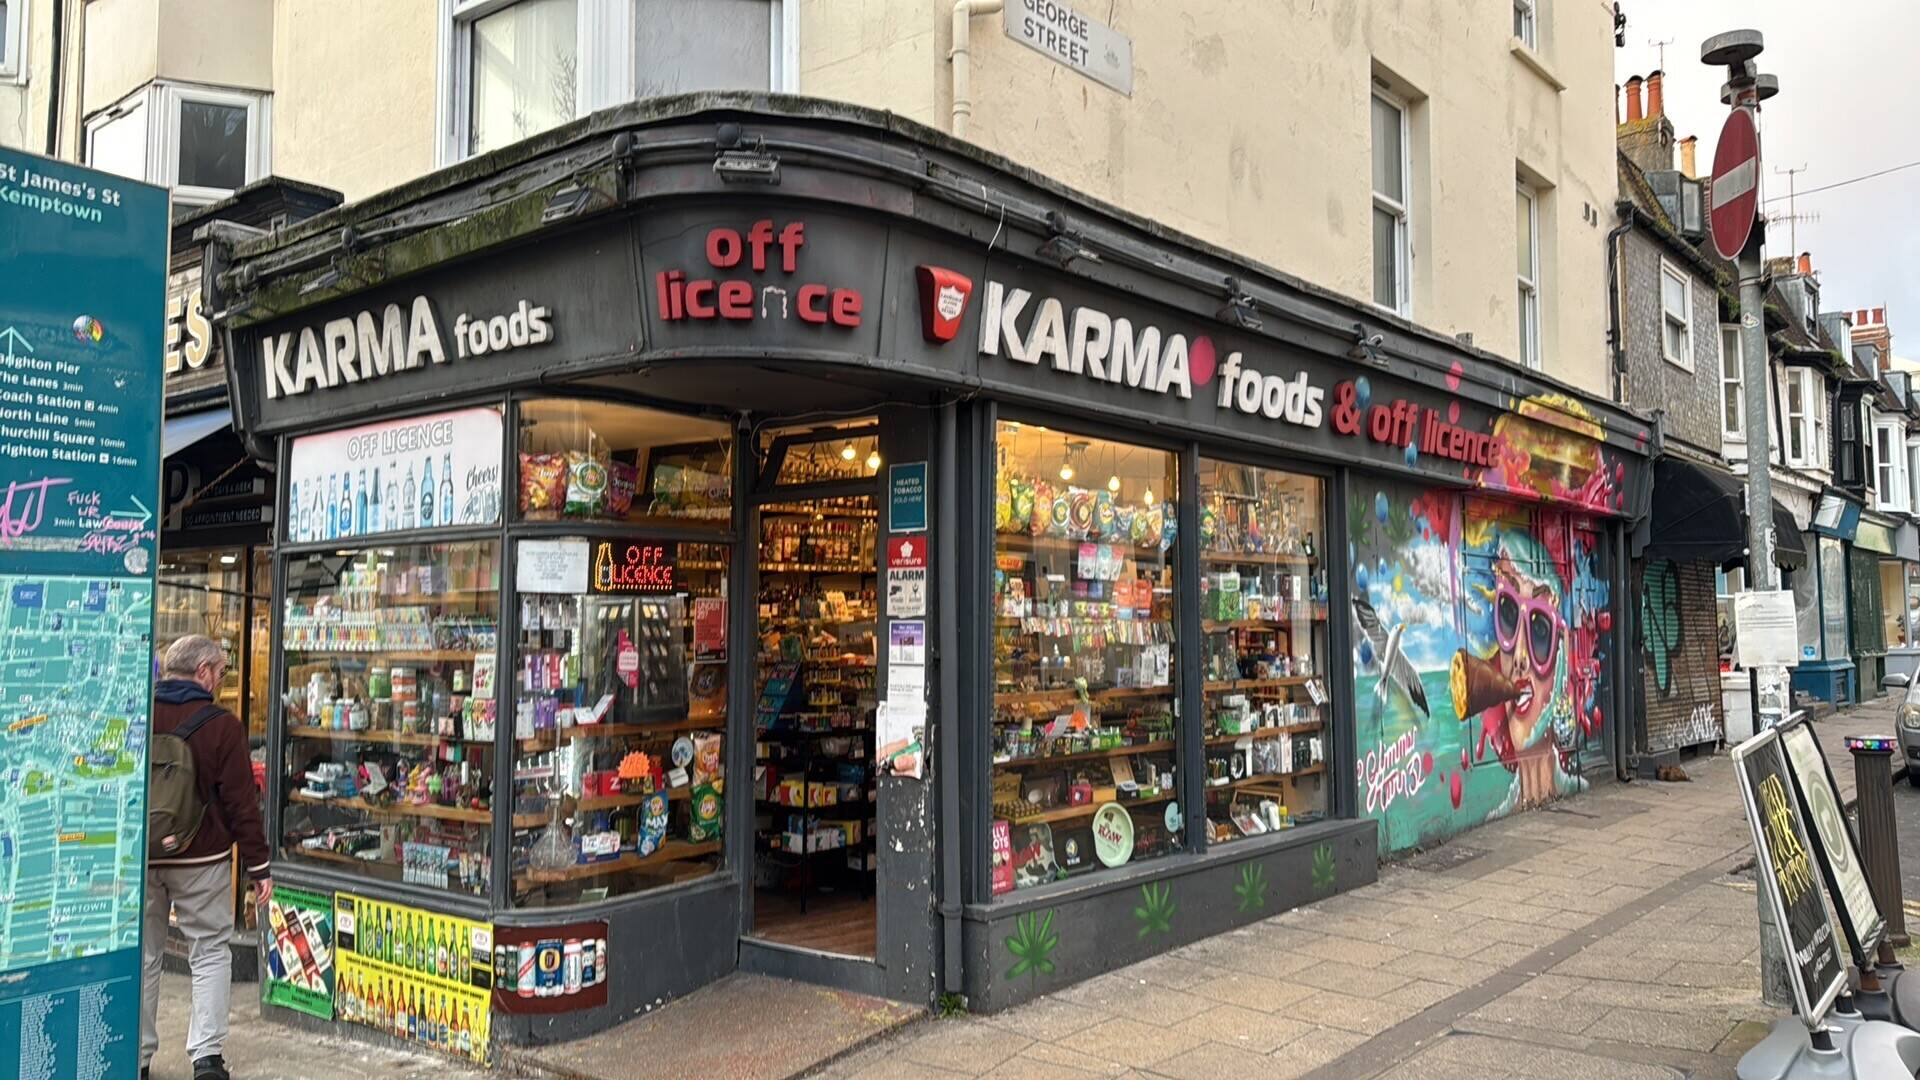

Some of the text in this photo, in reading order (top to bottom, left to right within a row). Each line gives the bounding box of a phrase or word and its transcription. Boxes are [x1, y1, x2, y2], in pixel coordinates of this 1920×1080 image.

[1024, 0, 1088, 41] GEORGE
[1023, 17, 1089, 66] STREET
[0, 163, 121, 207] St James's St
[705, 219, 805, 273] off
[262, 295, 556, 399] KARMA foods
[979, 279, 1325, 429] KARMA foods
[56, 361, 80, 376] Pier
[23, 374, 59, 390] Lanes
[0, 389, 33, 404] oach
[36, 393, 82, 410] Station
[35, 411, 69, 426] Laine
[1331, 380, 1500, 468] & off licence
[0, 424, 50, 442] hurchill
[53, 430, 96, 446] Square
[347, 419, 454, 461] OFF LICENCE
[51, 447, 96, 463] Station
[893, 485, 923, 495] TOBACCO
[896, 478, 920, 487] HEATED
[67, 491, 101, 506] FUCK
[893, 494, 923, 505] SOLD HERE
[78, 518, 104, 529] Law
[613, 545, 673, 584] OFF LICENCE
[891, 556, 922, 566] verisure
[889, 569, 925, 582] ALARM
[1097, 824, 1123, 844] RAW
